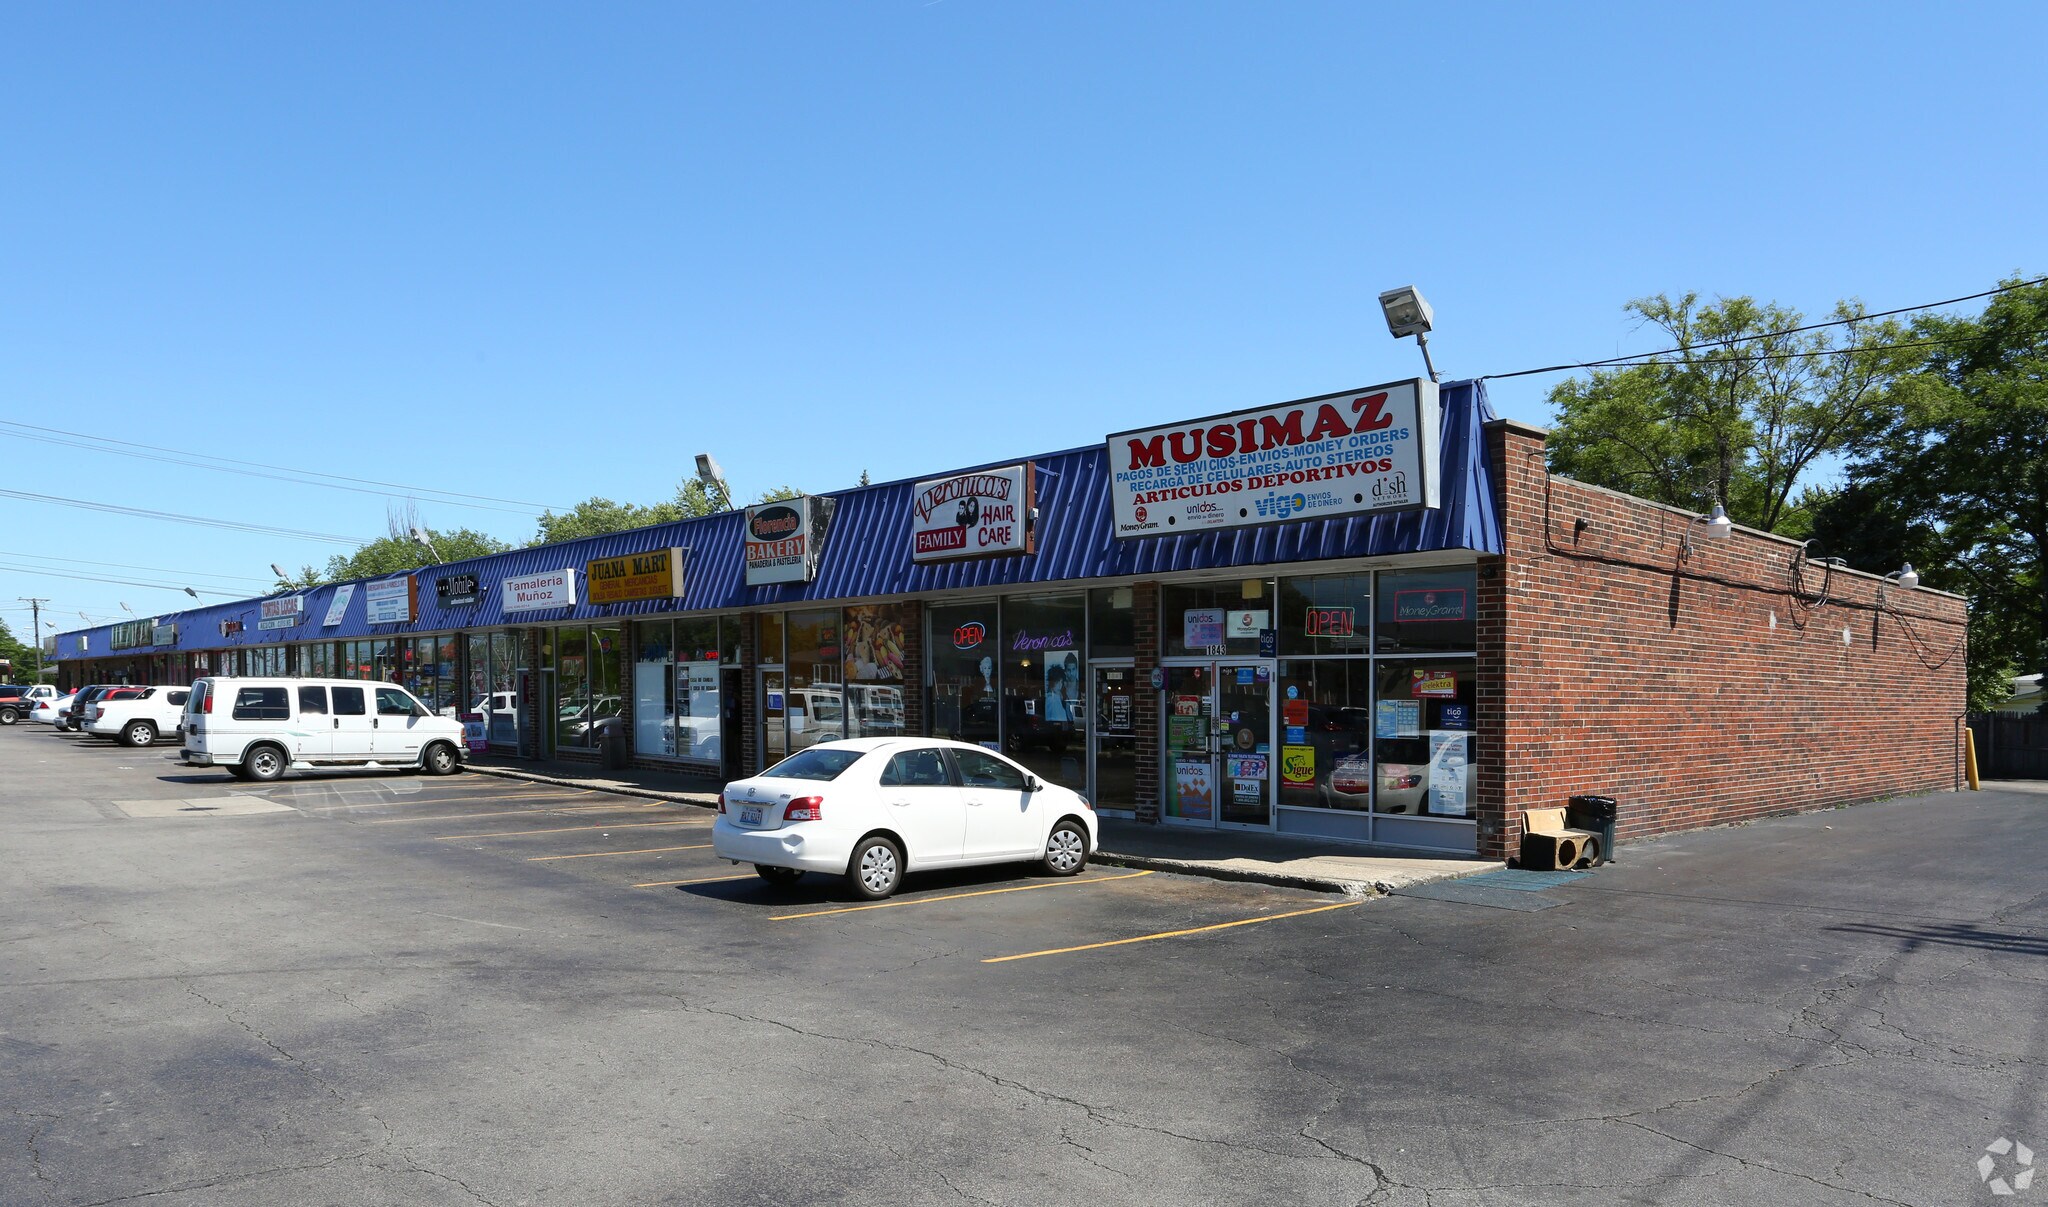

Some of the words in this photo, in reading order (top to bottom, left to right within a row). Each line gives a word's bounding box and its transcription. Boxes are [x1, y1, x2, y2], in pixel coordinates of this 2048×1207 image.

[1127, 392, 1393, 470] MUSIMAZ
[1117, 469, 1152, 482] PAGOS
[1157, 466, 1171, 477] DE
[1349, 428, 1409, 447] ORDERS
[1130, 478, 1184, 493] RECARGA
[1187, 474, 1199, 486] DE
[1327, 444, 1393, 465] STEREOS
[1132, 479, 1243, 505] ARTICULOS
[1247, 458, 1392, 490] DEPORTIVOS
[1372, 471, 1408, 497] dish
[915, 477, 1008, 524] Veronica's
[1255, 491, 1306, 518] vigo
[1307, 492, 1331, 501] ENVIOS
[1318, 498, 1342, 507] DINERO
[754, 513, 797, 535] Florencia
[981, 505, 1015, 525] HAIR
[919, 530, 963, 549] FAMILY
[978, 526, 1011, 546] CARE
[747, 538, 803, 560] BAKERY
[592, 560, 626, 581] JUANA
[633, 553, 667, 575] MART
[507, 576, 562, 591] Tamaleria
[281, 598, 297, 615] LOCAS
[517, 591, 552, 602] Muñoz
[1400, 605, 1462, 617] MoneyGram
[1307, 611, 1352, 635] OPEN
[953, 627, 982, 645] OPEN
[1013, 629, 1072, 650] Veronica's
[1207, 645, 1226, 656] 1843
[1177, 765, 1203, 775] unidos
[1284, 757, 1313, 778] Sigue
